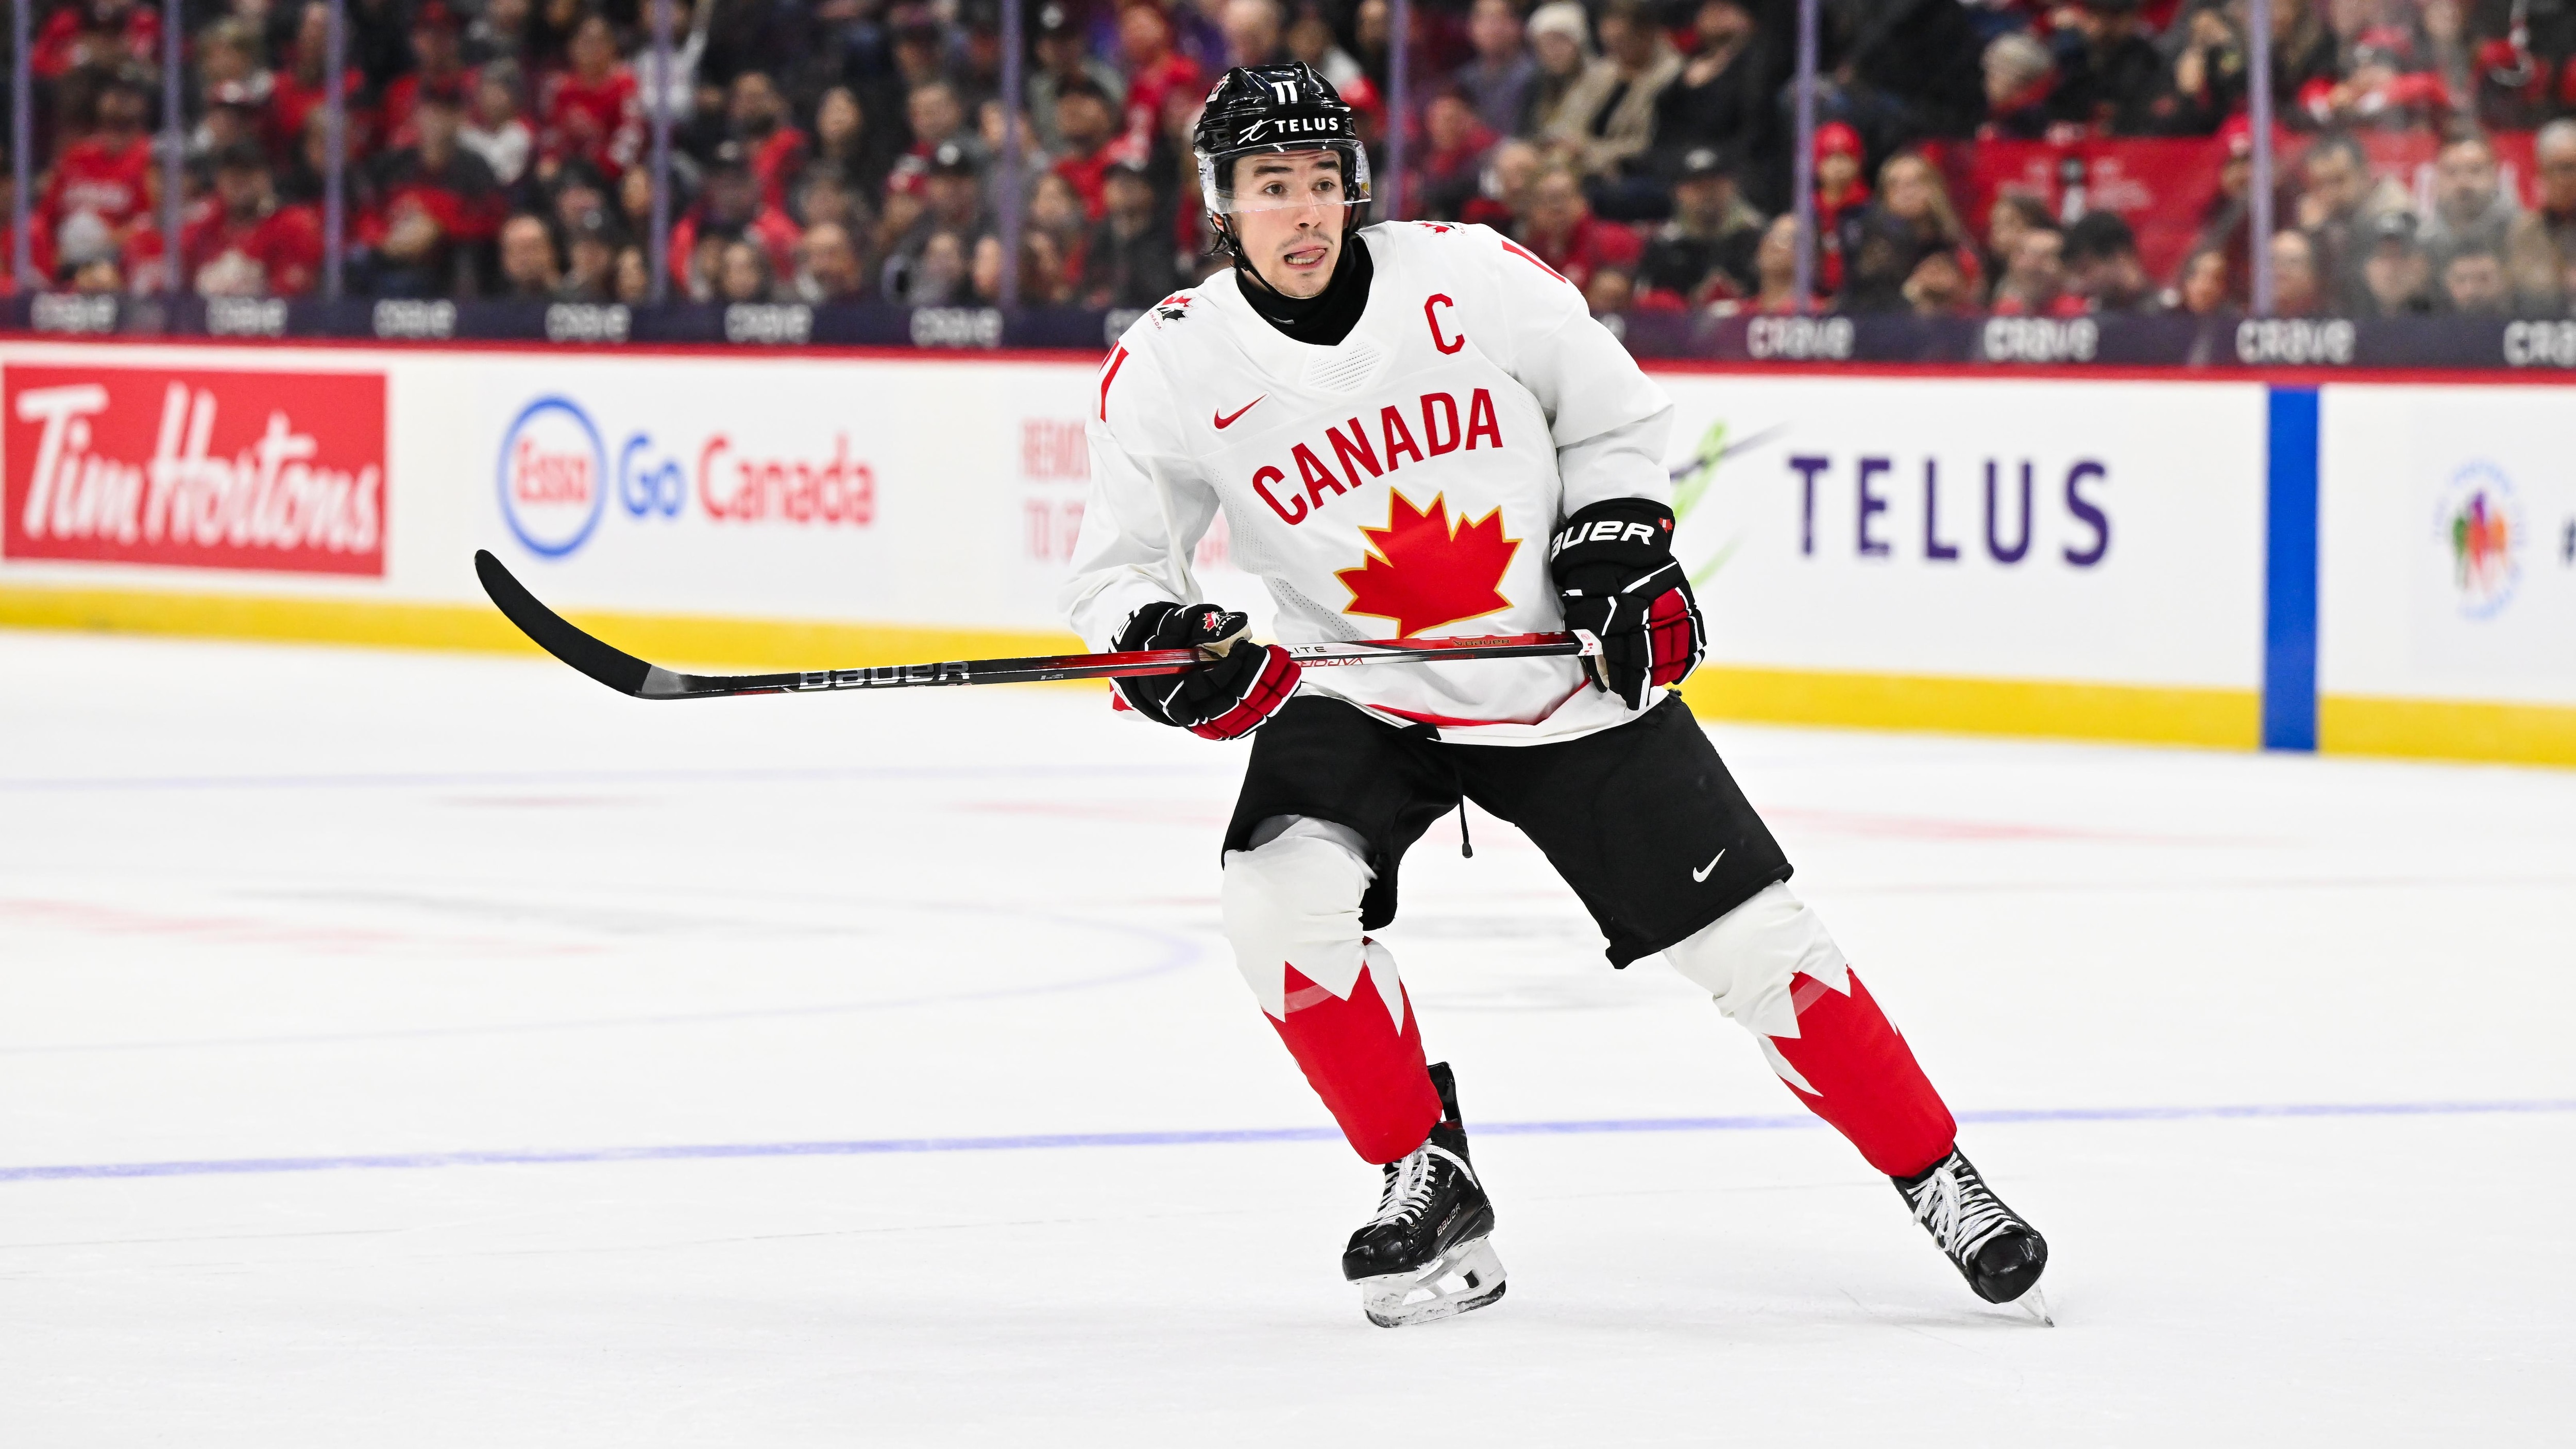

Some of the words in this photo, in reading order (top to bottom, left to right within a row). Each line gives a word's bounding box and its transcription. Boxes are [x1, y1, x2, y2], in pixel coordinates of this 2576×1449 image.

[1271, 80, 1298, 105] 11
[1275, 117, 1338, 133] TELUS
[1501, 240, 1567, 284] 1
[1148, 311, 1162, 330] ANADA
[1424, 293, 1465, 355] C
[2502, 320, 2576, 367] CRA
[15, 384, 144, 546] Tim
[144, 380, 380, 554] Hortons
[1252, 388, 1503, 525] CANADA
[618, 432, 686, 519] Go
[698, 432, 876, 527] Canada
[1788, 454, 2111, 567] TELUS
[1550, 520, 1654, 562] AUER
[799, 661, 970, 690] BAUER
[1436, 1202, 1461, 1237] BAUER
